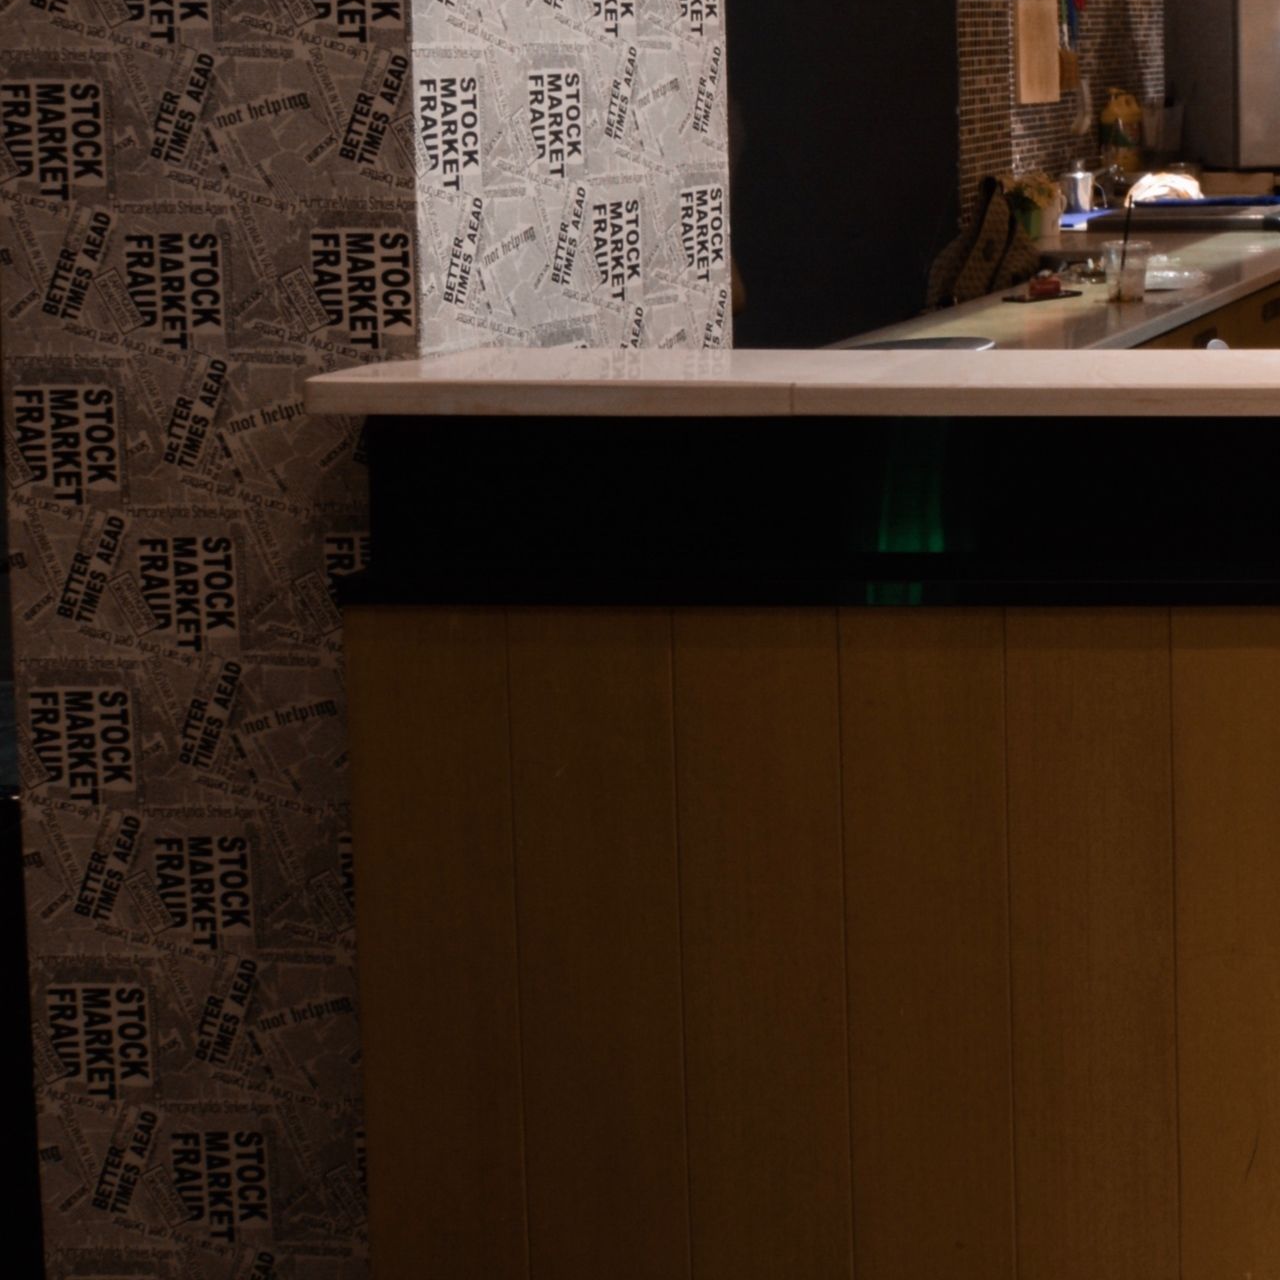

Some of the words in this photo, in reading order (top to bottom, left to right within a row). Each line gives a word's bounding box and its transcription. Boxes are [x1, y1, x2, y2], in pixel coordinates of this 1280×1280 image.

[2, 85, 34, 177] FRAUD
[36, 84, 69, 200] MARKET
[71, 84, 103, 178] STOCK
[420, 79, 438, 171] FRAUD
[440, 78, 459, 191] MARKET
[460, 77, 479, 168] STOCK
[693, 77, 707, 131] BETTER
[701, 93, 714, 134] TIMES
[61, 265, 93, 321] TIMES
[83, 212, 111, 262] AEAD
[484, 247, 500, 266] not
[501, 226, 536, 255] helping
[681, 192, 694, 267] FRAUD
[696, 190, 709, 282] MARKET
[710, 188, 723, 263] STOCK
[43, 248, 77, 317] BETTER
[312, 234, 343, 326] FRAUD
[345, 233, 377, 348] MARKET
[380, 233, 412, 327] STOCK
[58, 552, 91, 618] BETTER
[75, 570, 107, 622] TIMES
[30, 692, 62, 782] FRAUD
[64, 691, 98, 804] MARKET
[98, 691, 132, 782] STOCK
[172, 1133, 203, 1221] FRAUD
[204, 1132, 235, 1242] MARKET
[235, 1131, 267, 1221] STOCK
